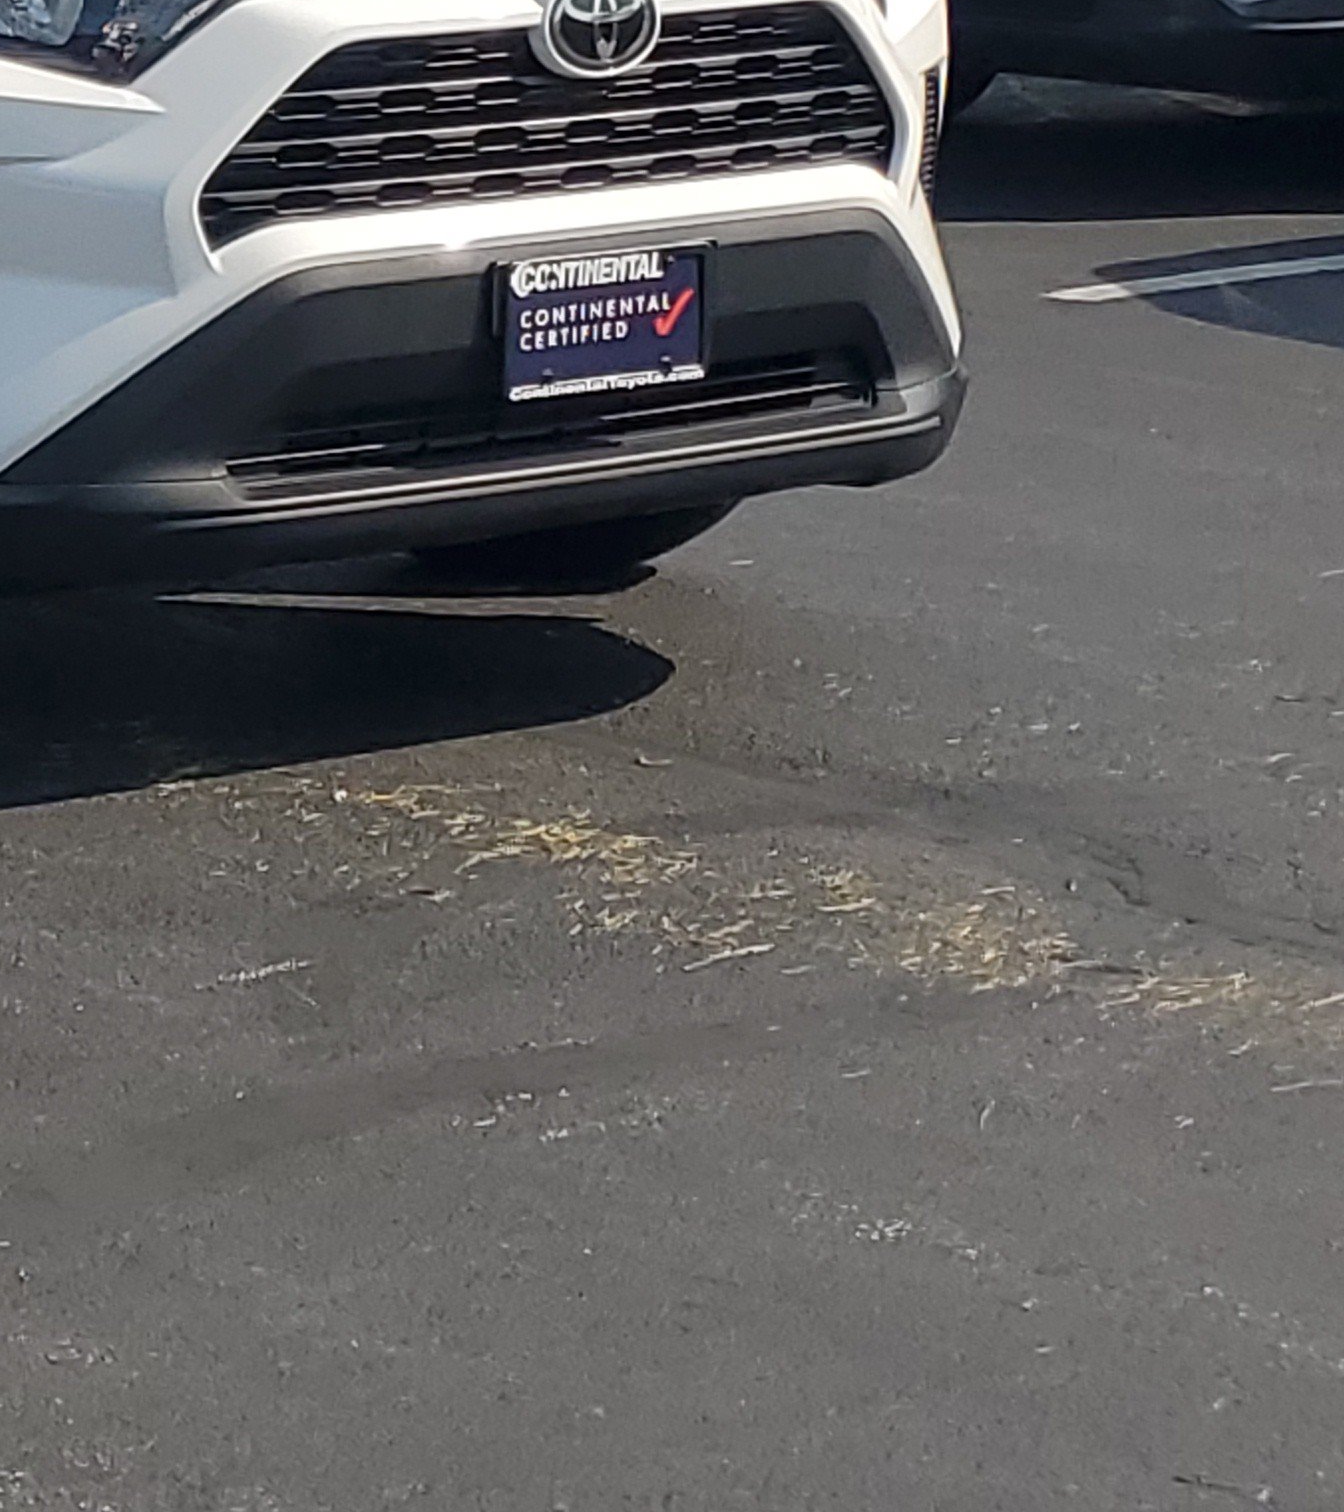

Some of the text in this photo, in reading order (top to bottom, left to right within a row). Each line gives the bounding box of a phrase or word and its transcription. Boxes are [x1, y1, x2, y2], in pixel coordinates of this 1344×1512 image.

[510, 251, 665, 298] CONTINENTAL
[519, 291, 671, 329] CONTINENTAL
[519, 320, 629, 352] CERTIFIED
